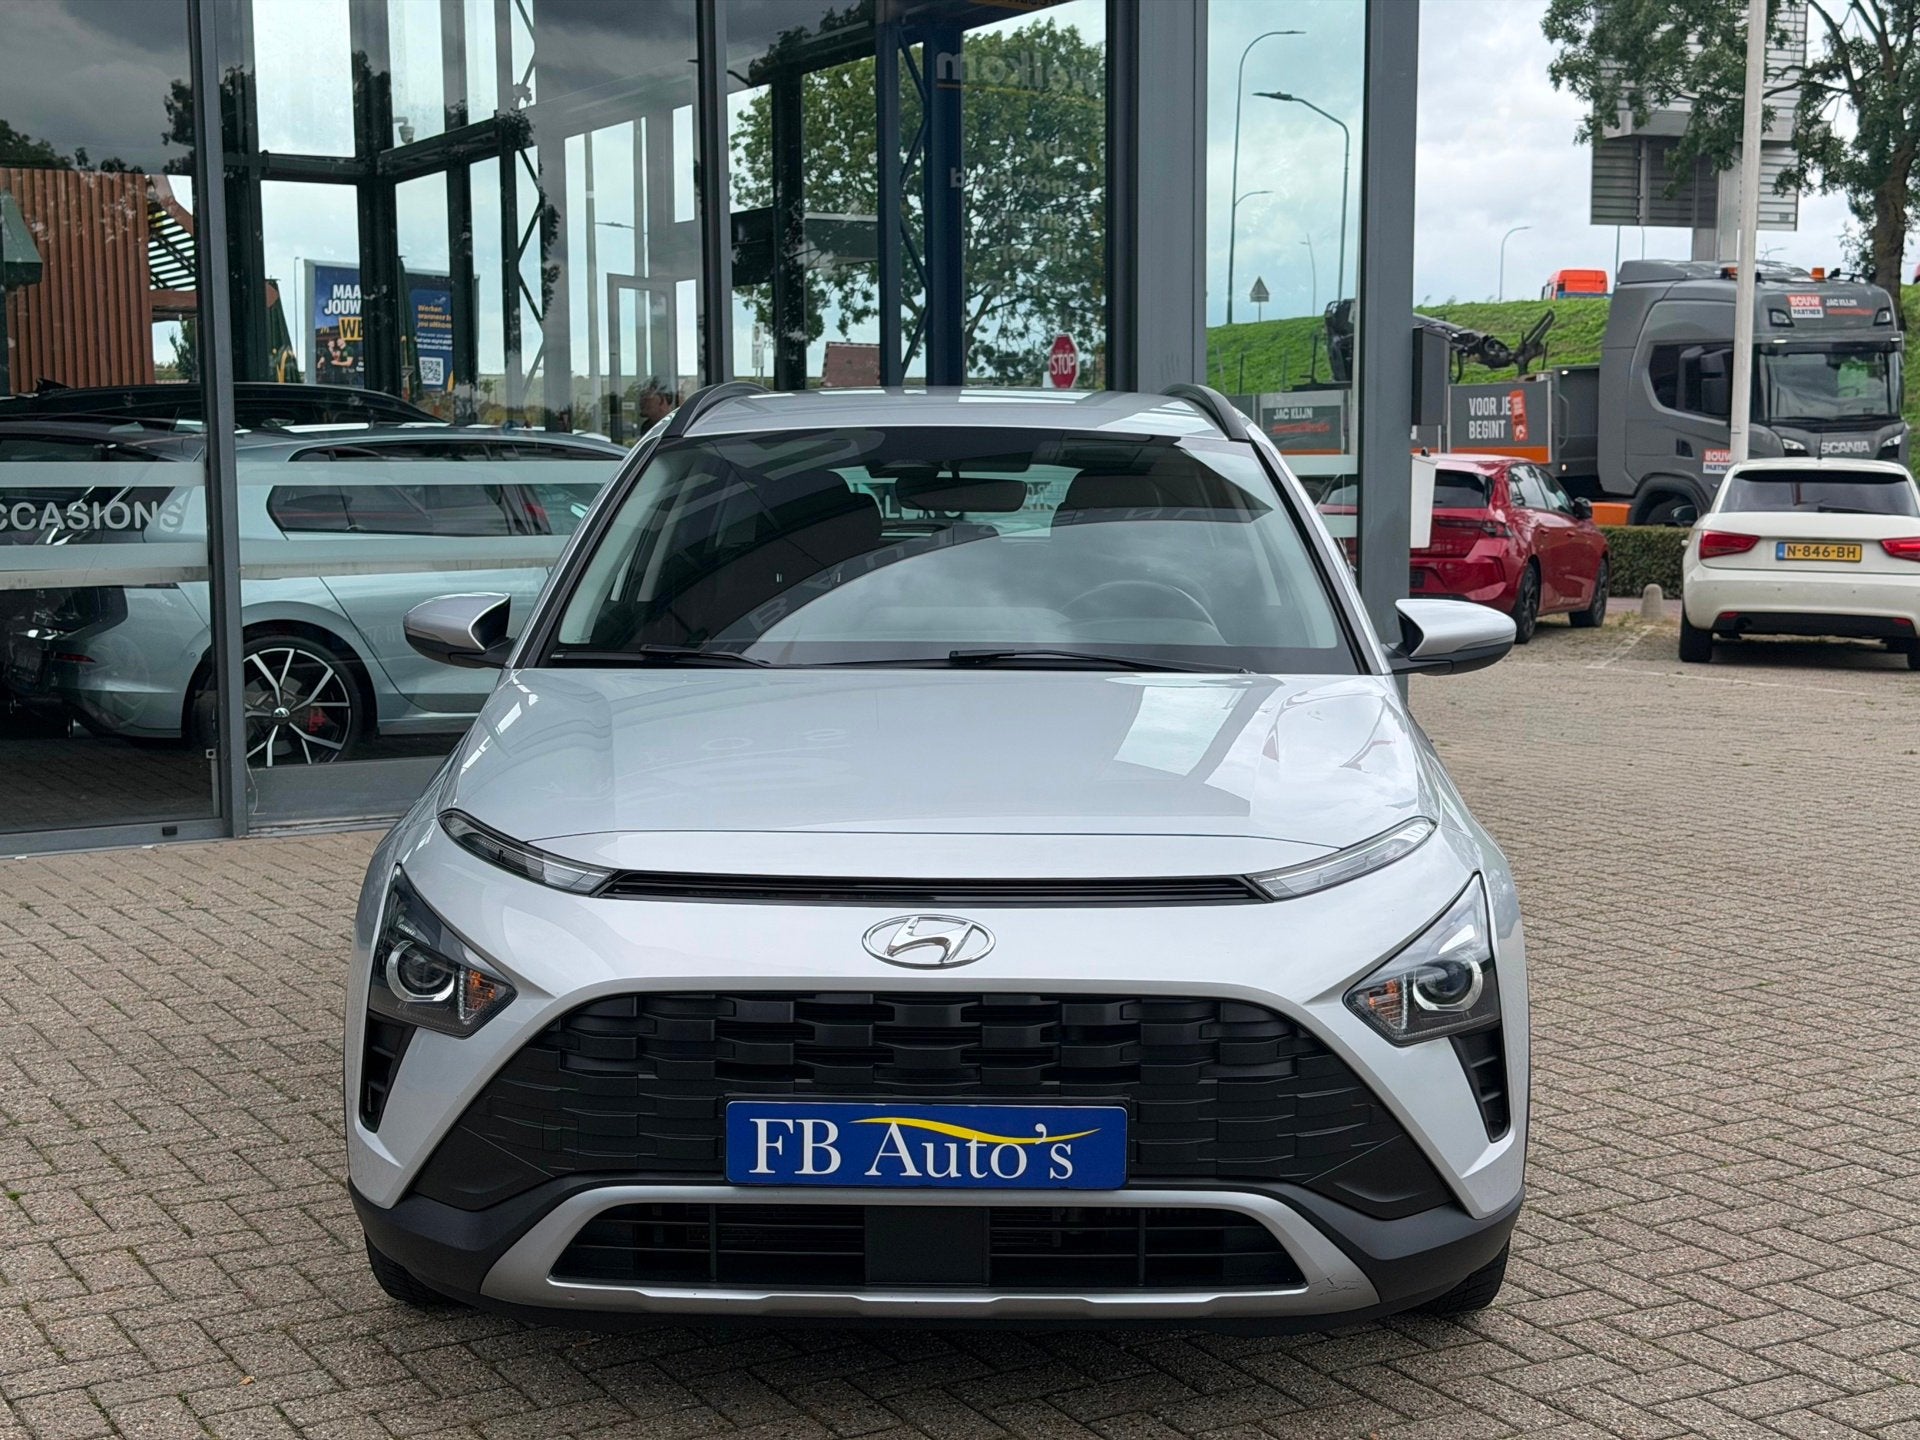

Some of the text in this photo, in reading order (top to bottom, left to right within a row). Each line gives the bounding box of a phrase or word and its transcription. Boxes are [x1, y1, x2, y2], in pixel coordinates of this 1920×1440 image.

[333, 284, 362, 299] MAA
[324, 299, 362, 315] JOUW
[1789, 296, 1820, 306] BOUW
[1051, 353, 1076, 375] STOP
[1468, 397, 1497, 416] VOOR
[1500, 396, 1512, 415] JE
[1273, 408, 1289, 420] JAC
[1468, 420, 1506, 439] BEGINT
[1821, 441, 1870, 454] SCANIA
[1786, 545, 1857, 559] N-846-BH
[748, 1118, 1074, 1180] FB Auto's
